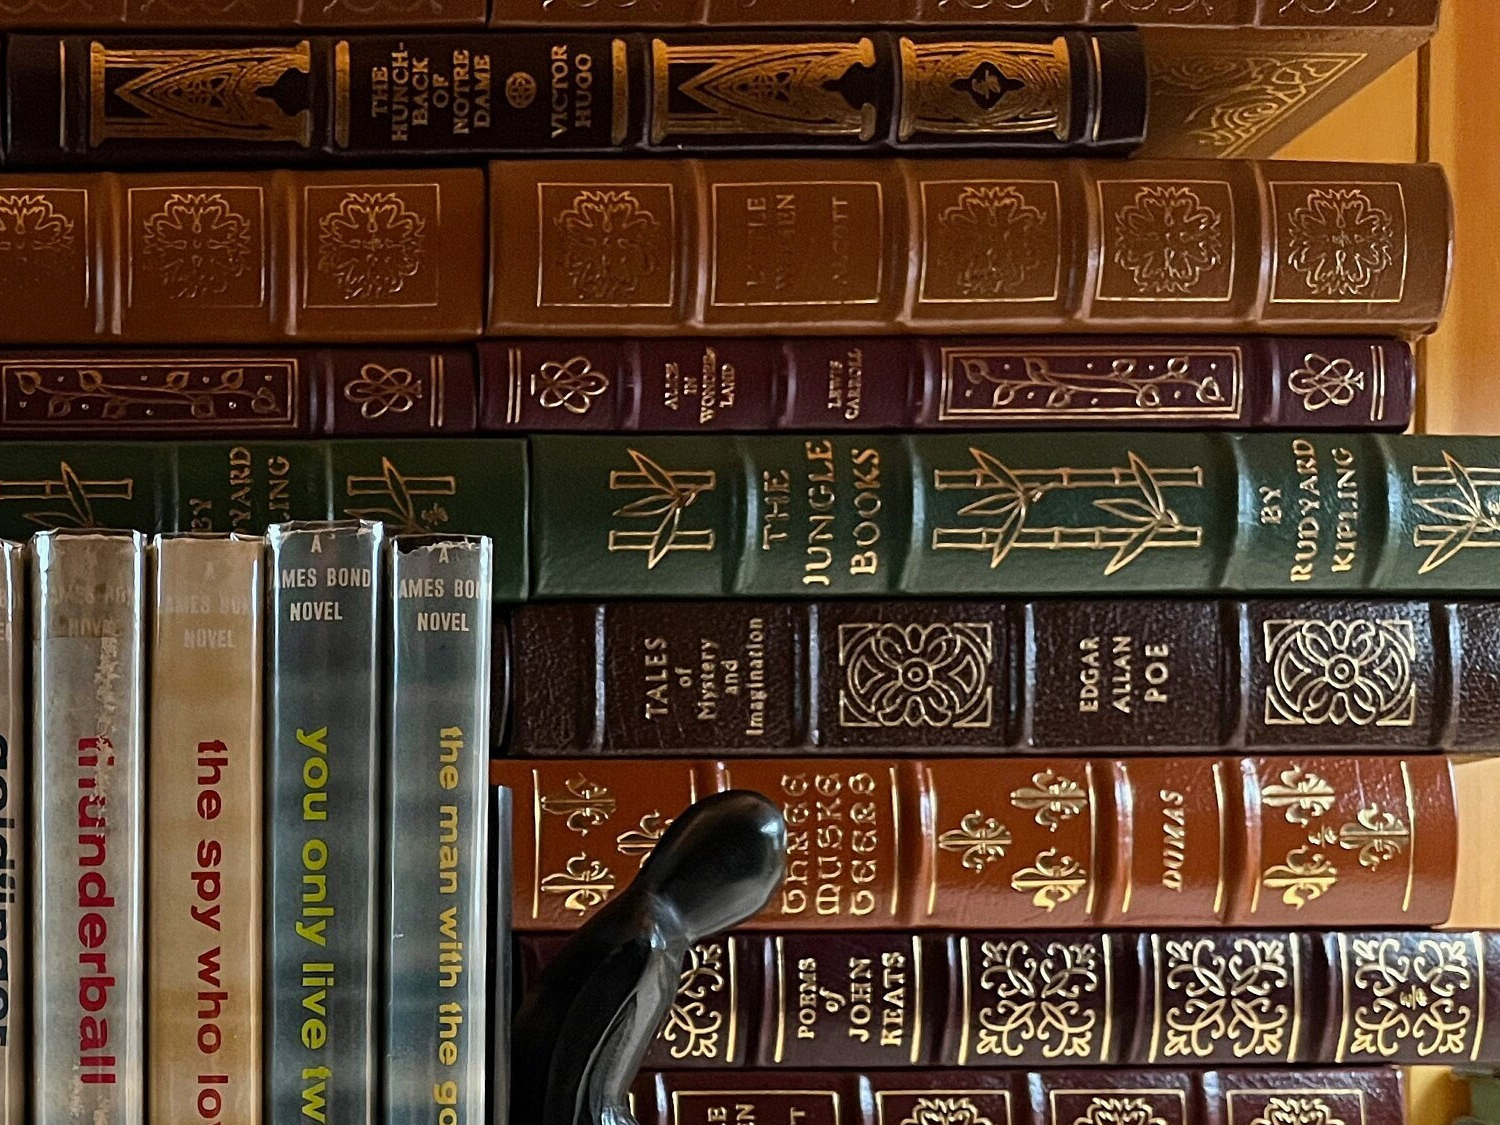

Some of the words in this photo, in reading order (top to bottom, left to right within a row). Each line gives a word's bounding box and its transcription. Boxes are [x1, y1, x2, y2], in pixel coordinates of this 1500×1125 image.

[371, 66, 388, 117] THE
[412, 57, 429, 126] BACK
[432, 74, 449, 108] OF
[453, 50, 470, 134] NOTRE
[473, 55, 491, 128] DAME
[551, 44, 568, 138] VICTOR
[575, 53, 592, 127] HUGO
[763, 469, 790, 550] THE
[802, 439, 836, 586] JUNGLE
[850, 447, 882, 576] BOOKS
[1260, 484, 1282, 525] BY
[1290, 438, 1321, 582] RUDYARD
[1330, 446, 1359, 572] KIPLING
[290, 602, 343, 621] NOVEL
[327, 568, 371, 587] BOND
[183, 629, 237, 648] NOVEL
[418, 612, 469, 632] NOVEL
[644, 637, 668, 720] TALES
[675, 667, 693, 688] of
[697, 638, 718, 720] Mystery
[720, 659, 740, 695] and
[1079, 635, 1101, 713] EDGAR
[1111, 634, 1132, 714] ALLAN
[1144, 642, 1170, 704] POE
[197, 739, 229, 820] the
[296, 726, 329, 822] you
[439, 726, 464, 791] the
[440, 805, 458, 895] man
[1159, 789, 1185, 893] DUMAS
[190, 840, 222, 931] spy
[296, 840, 333, 947] only
[439, 907, 464, 989] with
[197, 947, 229, 1054] who
[301, 962, 333, 1050] live
[439, 1002, 463, 1066] the
[798, 957, 817, 1039] POEMS
[819, 987, 846, 1013] of
[848, 956, 873, 1042] JOHN
[880, 951, 906, 1047] KEATS
